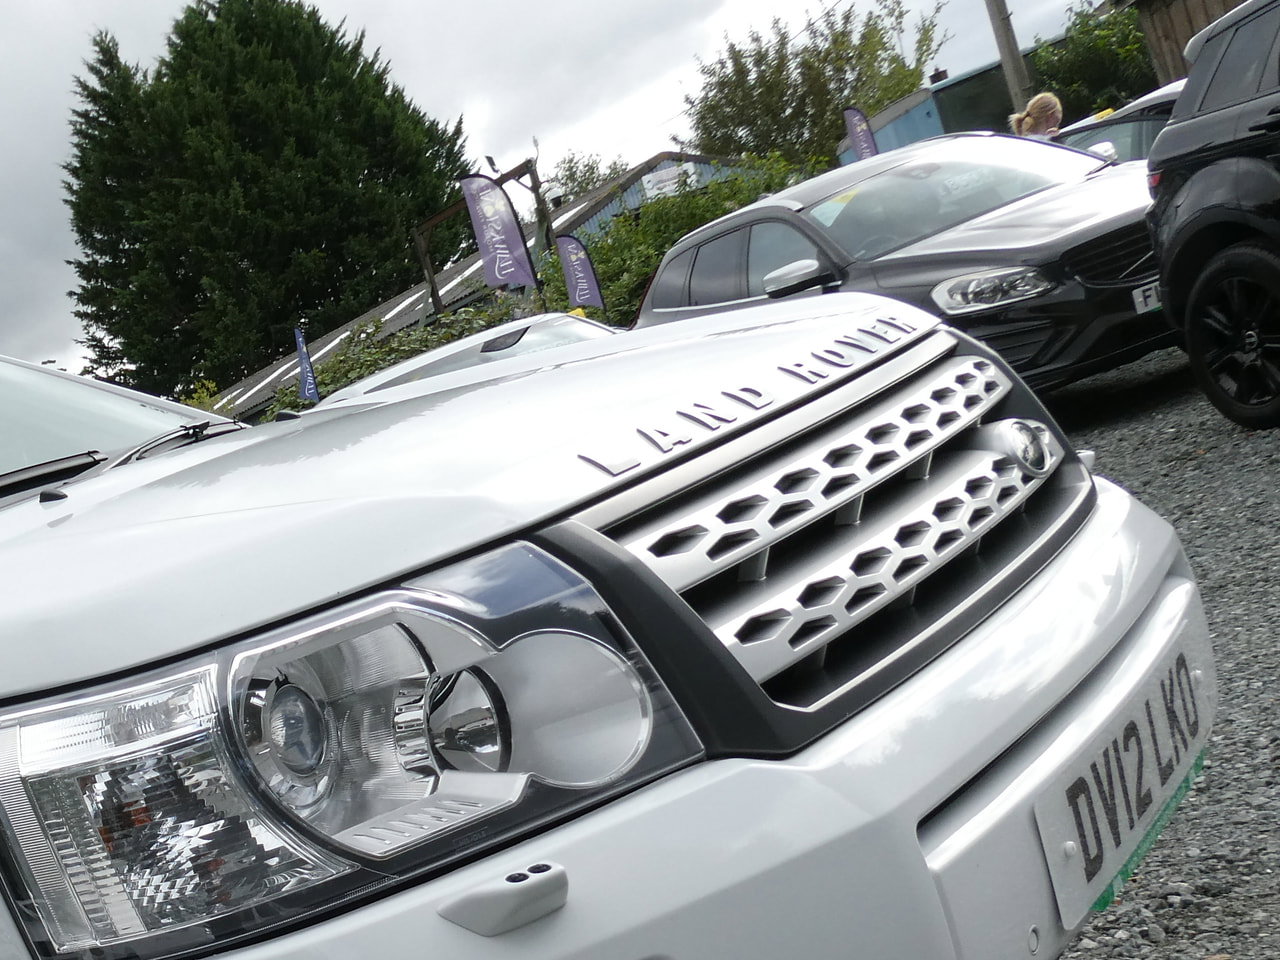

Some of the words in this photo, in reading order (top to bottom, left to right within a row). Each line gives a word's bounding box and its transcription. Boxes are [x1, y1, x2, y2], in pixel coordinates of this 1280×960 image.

[577, 387, 774, 477] LAND
[777, 317, 918, 384] ROVER
[1065, 719, 1153, 884] DV12
